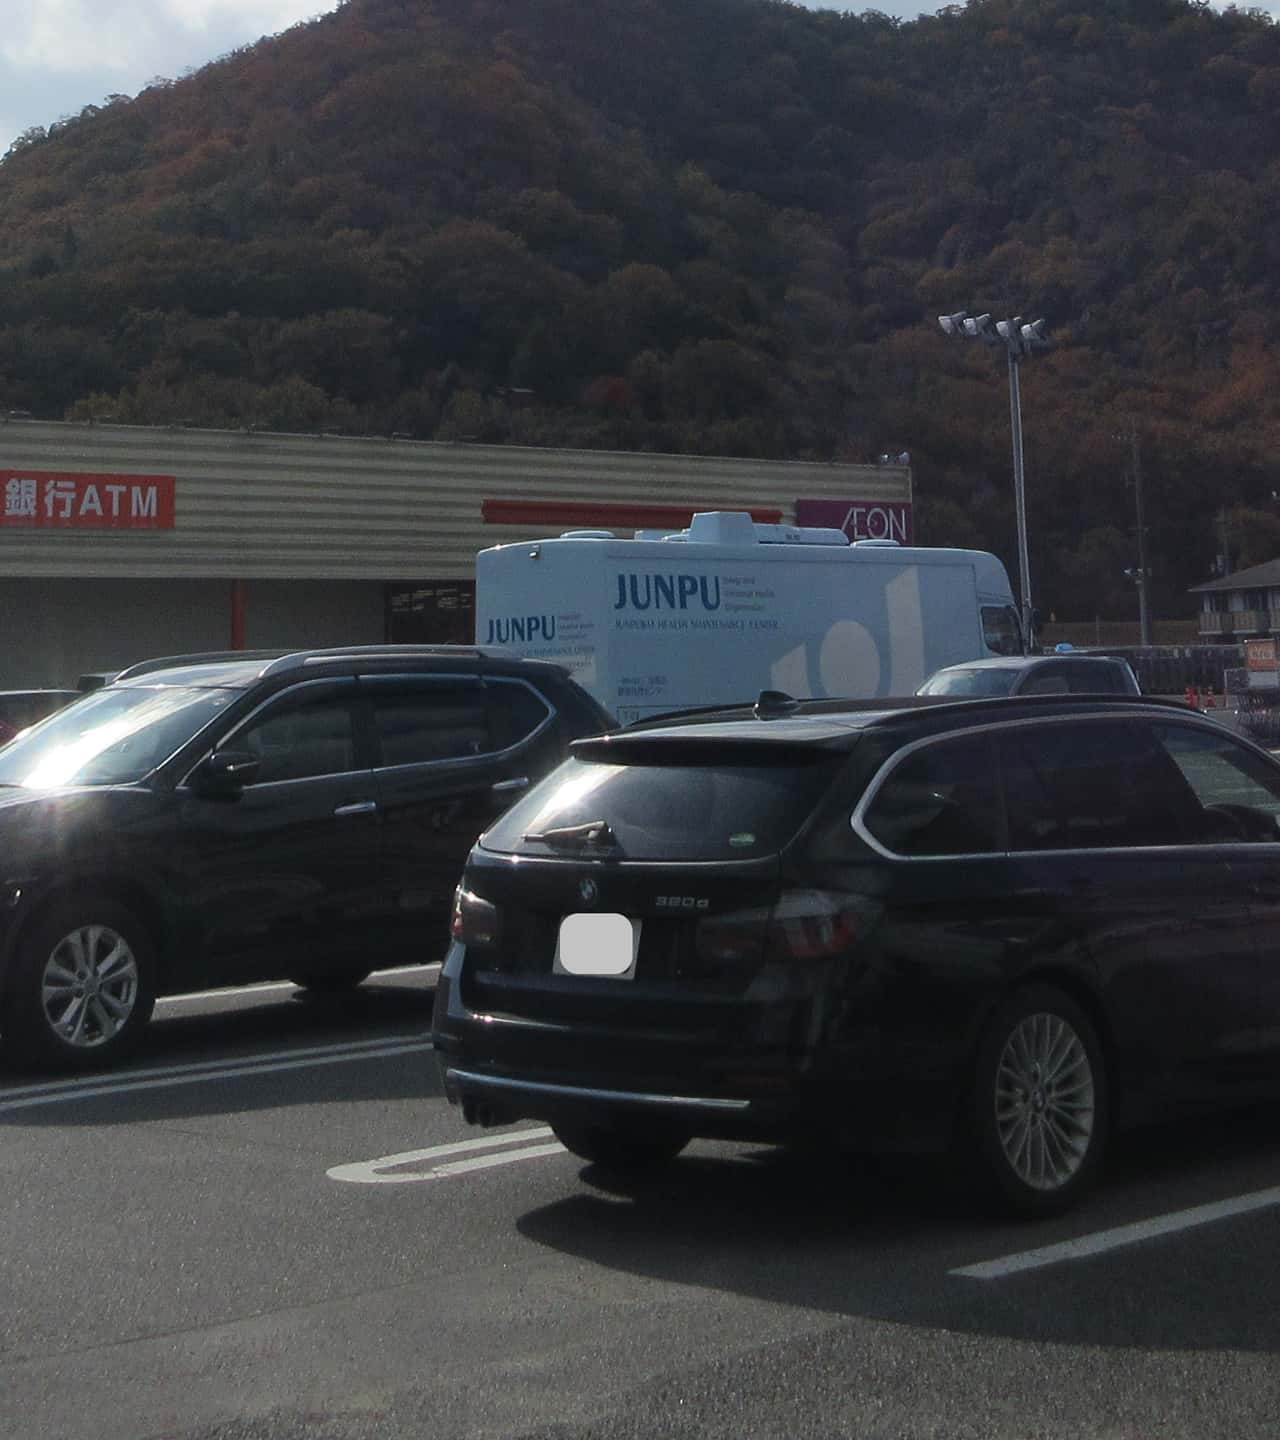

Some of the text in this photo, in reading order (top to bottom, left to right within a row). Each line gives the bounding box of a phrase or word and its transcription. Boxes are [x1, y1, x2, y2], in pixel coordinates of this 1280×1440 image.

[4, 477, 158, 518] 銀行ATM
[614, 573, 721, 610] JUNPU
[487, 615, 556, 644] JUNPU
